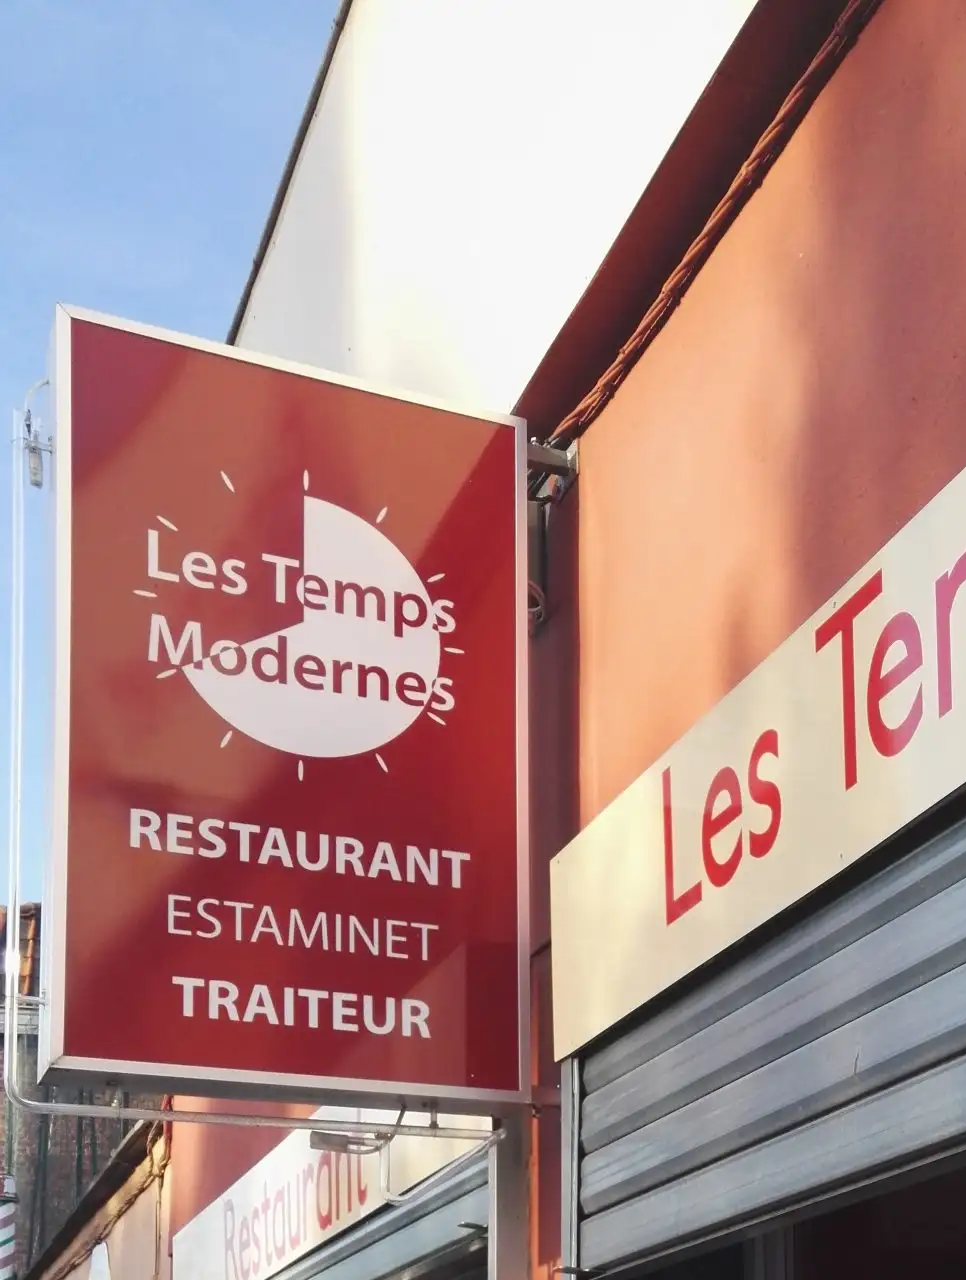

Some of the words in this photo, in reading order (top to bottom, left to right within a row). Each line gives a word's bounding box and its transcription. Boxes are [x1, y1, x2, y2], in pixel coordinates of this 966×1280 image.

[147, 528, 249, 596] Les
[261, 552, 458, 638] Temps
[147, 613, 457, 712] Modernes
[129, 807, 472, 889] RESTAURANT
[661, 723, 783, 928] Les
[167, 893, 440, 962] ESTAMINET
[172, 975, 432, 1039] TRAITEUR
